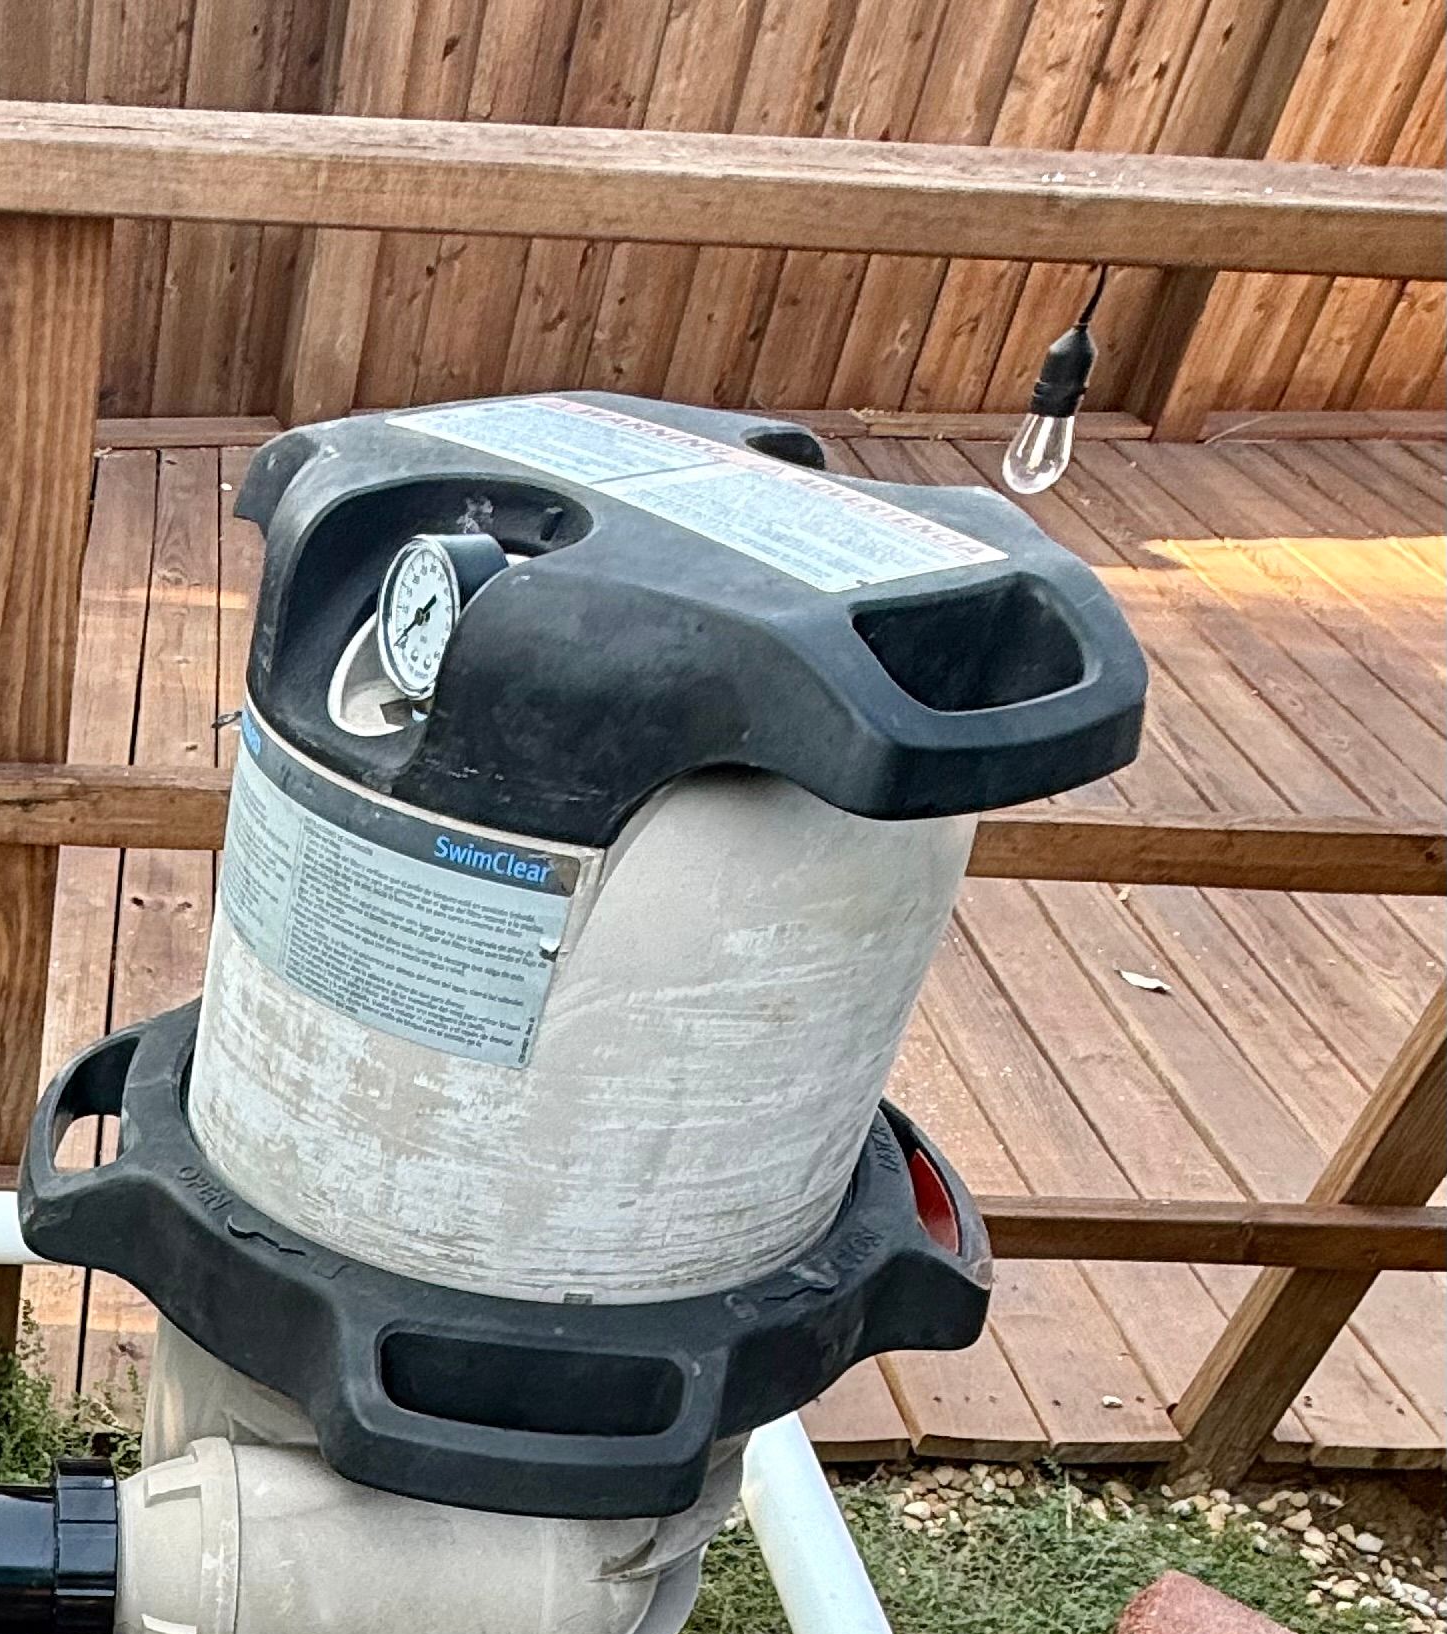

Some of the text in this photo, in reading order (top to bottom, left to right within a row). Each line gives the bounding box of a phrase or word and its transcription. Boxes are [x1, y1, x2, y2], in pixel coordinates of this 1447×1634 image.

[795, 474, 986, 555] ADVERTENCIA
[433, 833, 551, 884] SwimClear
[176, 1166, 233, 1212] OPEN
